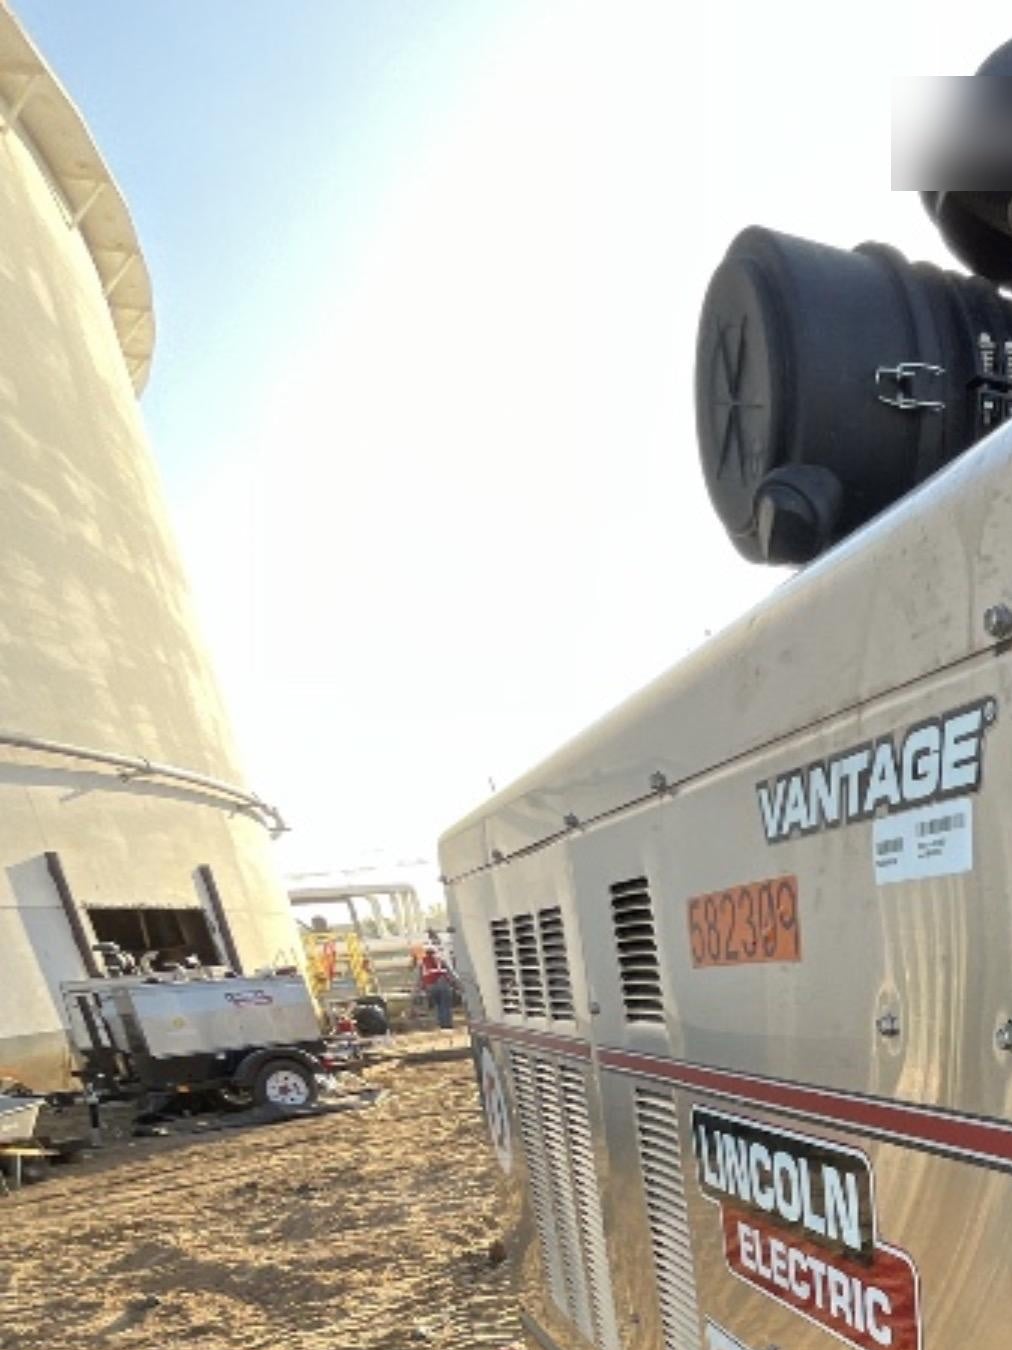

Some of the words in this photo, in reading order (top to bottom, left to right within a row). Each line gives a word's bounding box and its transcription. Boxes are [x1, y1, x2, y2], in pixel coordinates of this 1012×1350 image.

[756, 706, 985, 843] VANTAGE
[688, 878, 799, 966] 582309
[698, 1121, 862, 1250] LINCOLN
[737, 1219, 894, 1348] ELECTRIC
